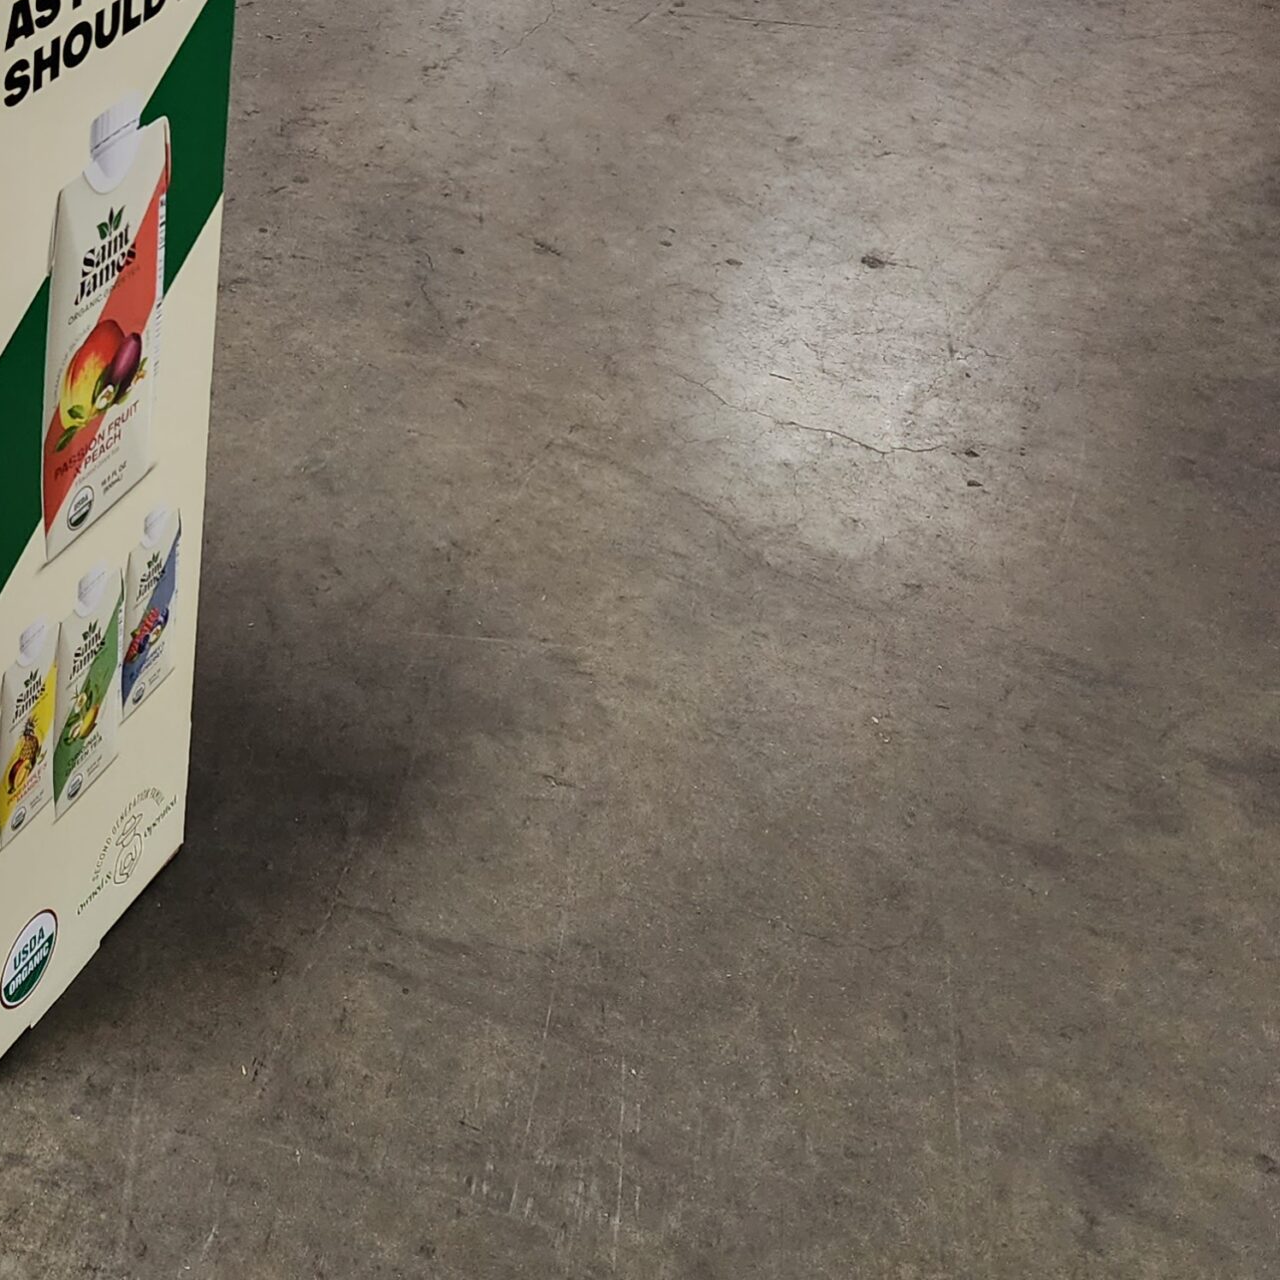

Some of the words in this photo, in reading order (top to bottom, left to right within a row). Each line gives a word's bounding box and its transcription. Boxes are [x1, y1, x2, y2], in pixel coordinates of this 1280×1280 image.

[74, 242, 136, 306] James
[82, 223, 130, 278] Saint
[107, 400, 140, 436] FRUIT
[84, 429, 122, 469] PEACH
[8, 941, 50, 997] ORGANIC
[13, 926, 46, 971] USDA
